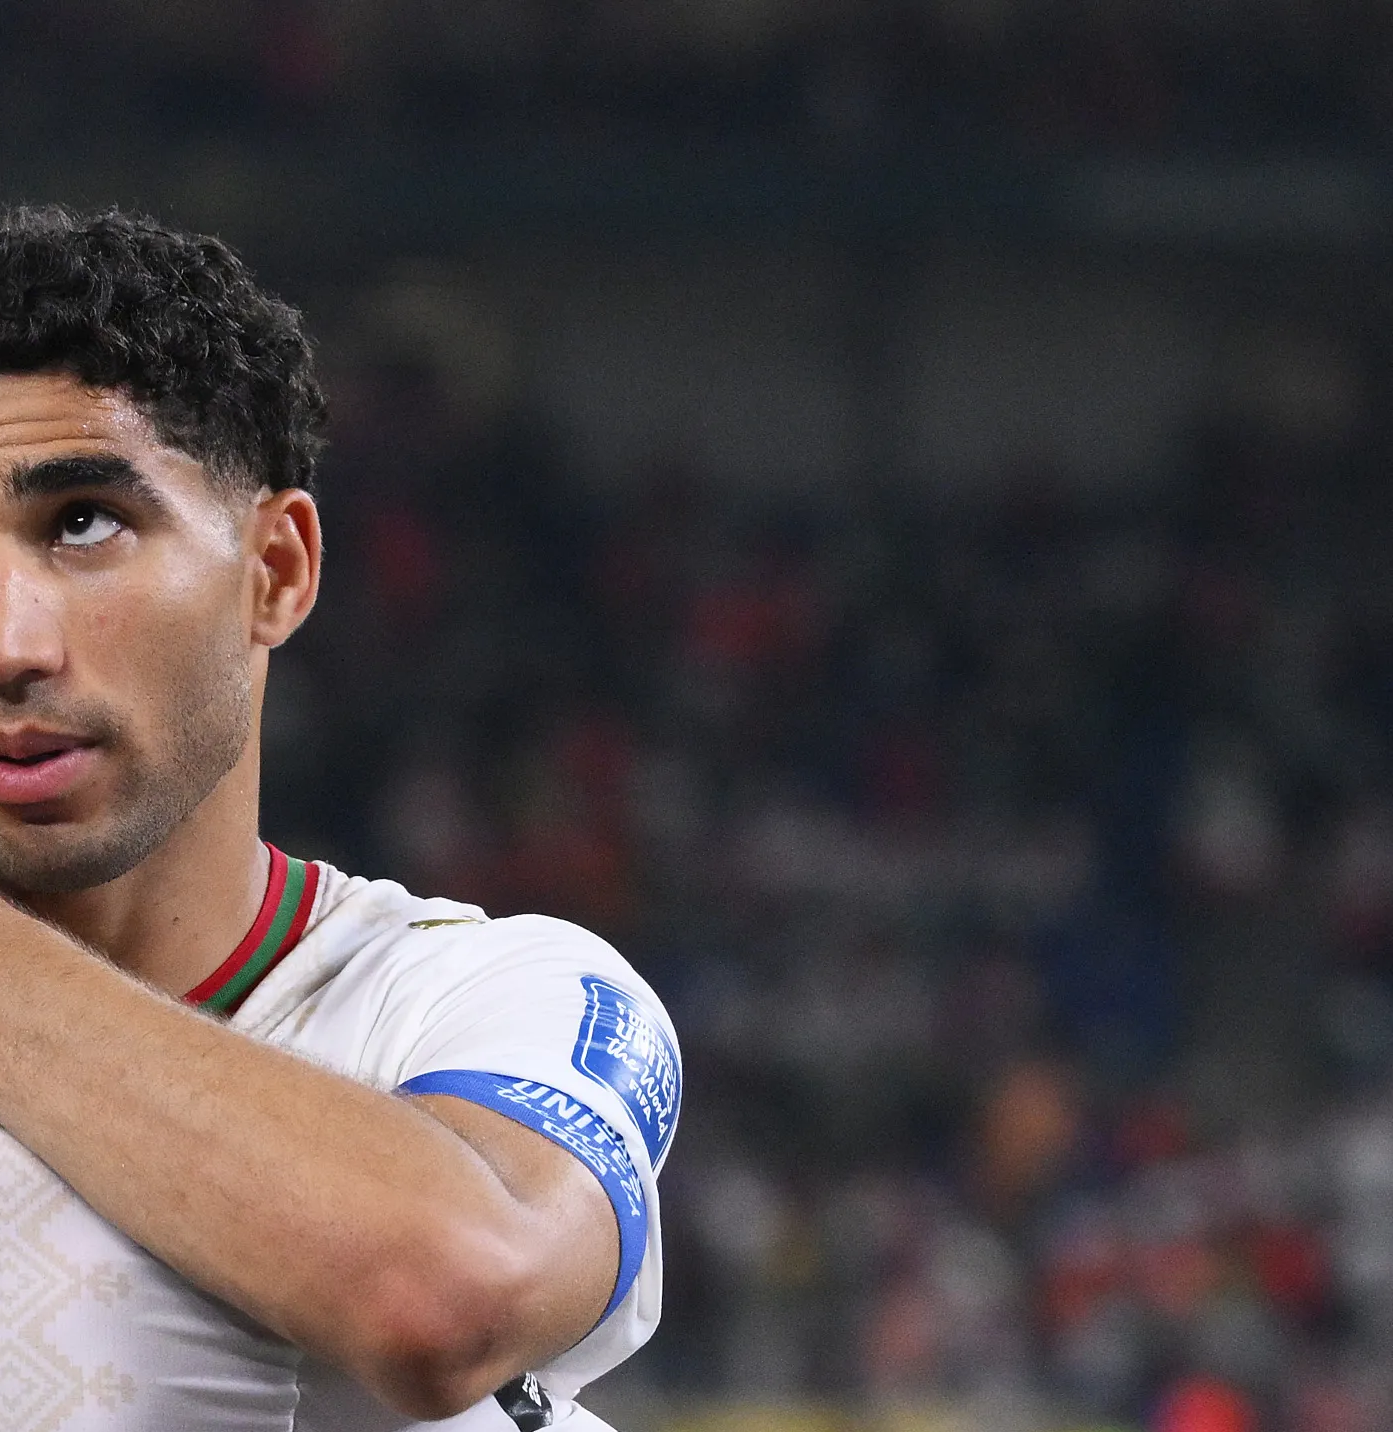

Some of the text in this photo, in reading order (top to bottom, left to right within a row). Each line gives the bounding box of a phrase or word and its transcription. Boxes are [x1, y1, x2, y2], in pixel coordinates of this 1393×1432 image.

[605, 1036, 669, 1142] the World
[615, 1016, 675, 1114] UNITES
[629, 1078, 651, 1125] FIFA
[513, 1081, 642, 1203] UNITES
